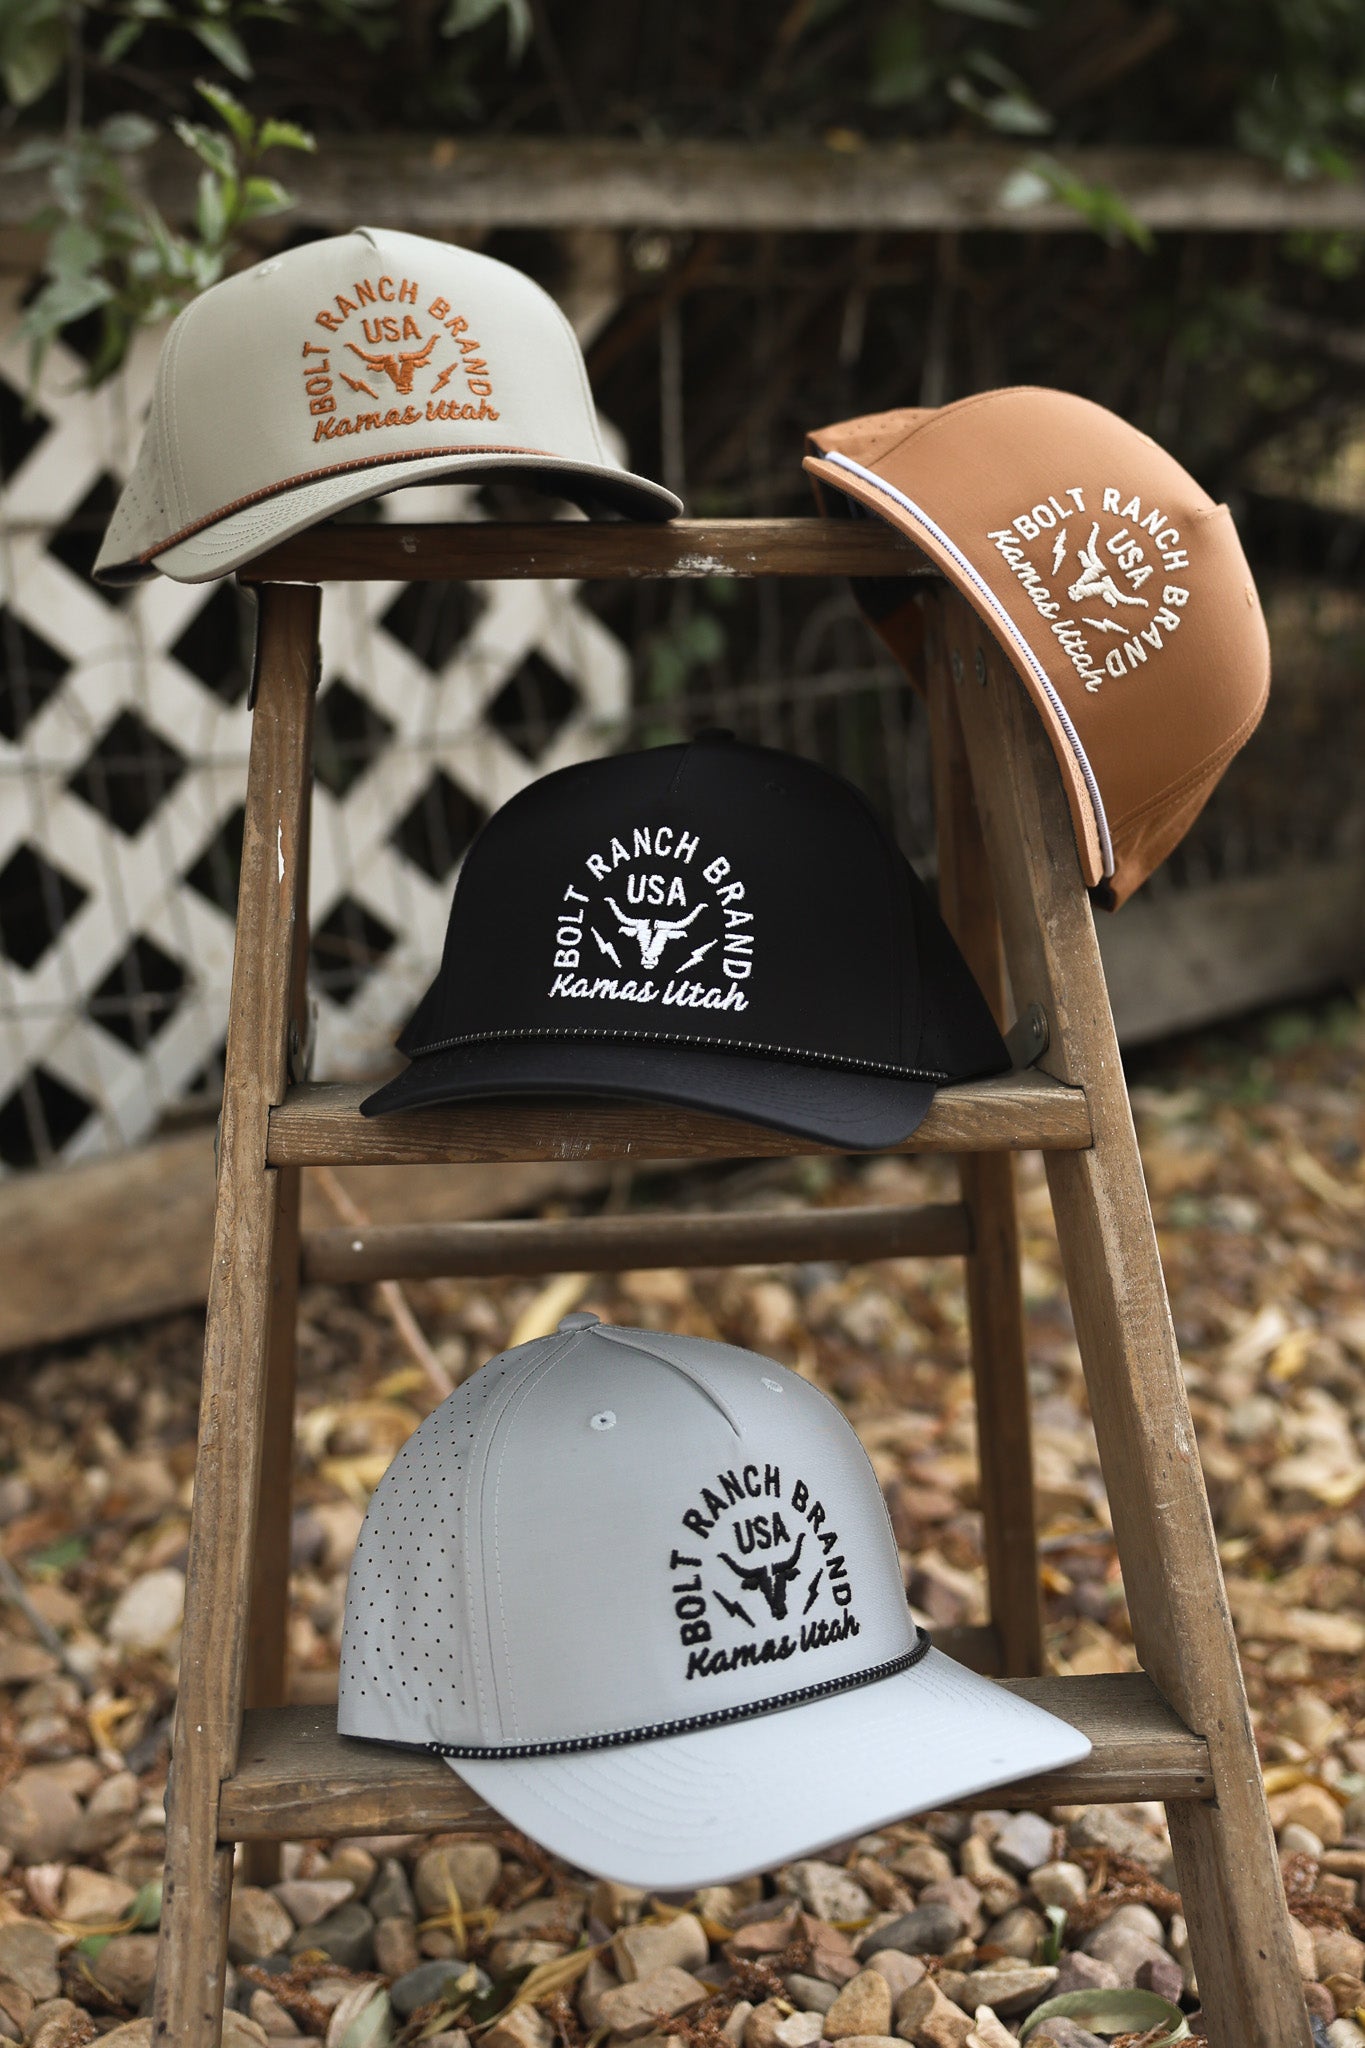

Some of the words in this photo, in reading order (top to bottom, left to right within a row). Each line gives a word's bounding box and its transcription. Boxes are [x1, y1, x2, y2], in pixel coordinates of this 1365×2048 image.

[315, 276, 419, 332] RANCH
[361, 315, 422, 343] USA
[302, 341, 337, 416] BOLT
[428, 296, 493, 396] BRAND
[312, 404, 422, 443] Kamas
[426, 398, 500, 421] Utah
[1012, 487, 1086, 541] BOLT
[1102, 487, 1189, 572] RANCH
[1106, 528, 1154, 590] USA
[987, 529, 1061, 620] Kamas
[1051, 619, 1106, 693] Utah
[1105, 585, 1190, 678] BRAND
[553, 884, 589, 968] BOLT
[585, 826, 700, 881] RANCH
[702, 856, 754, 979] BRAND
[627, 873, 687, 907] USA
[548, 973, 660, 1003] Kamas
[661, 979, 749, 1011] Utah
[682, 1463, 781, 1539] RANCH
[732, 1511, 791, 1555] USA
[791, 1479, 852, 1606] BRAND
[670, 1549, 712, 1646] BOLT
[686, 1635, 797, 1680] Kamas
[800, 1607, 860, 1652] Utah
